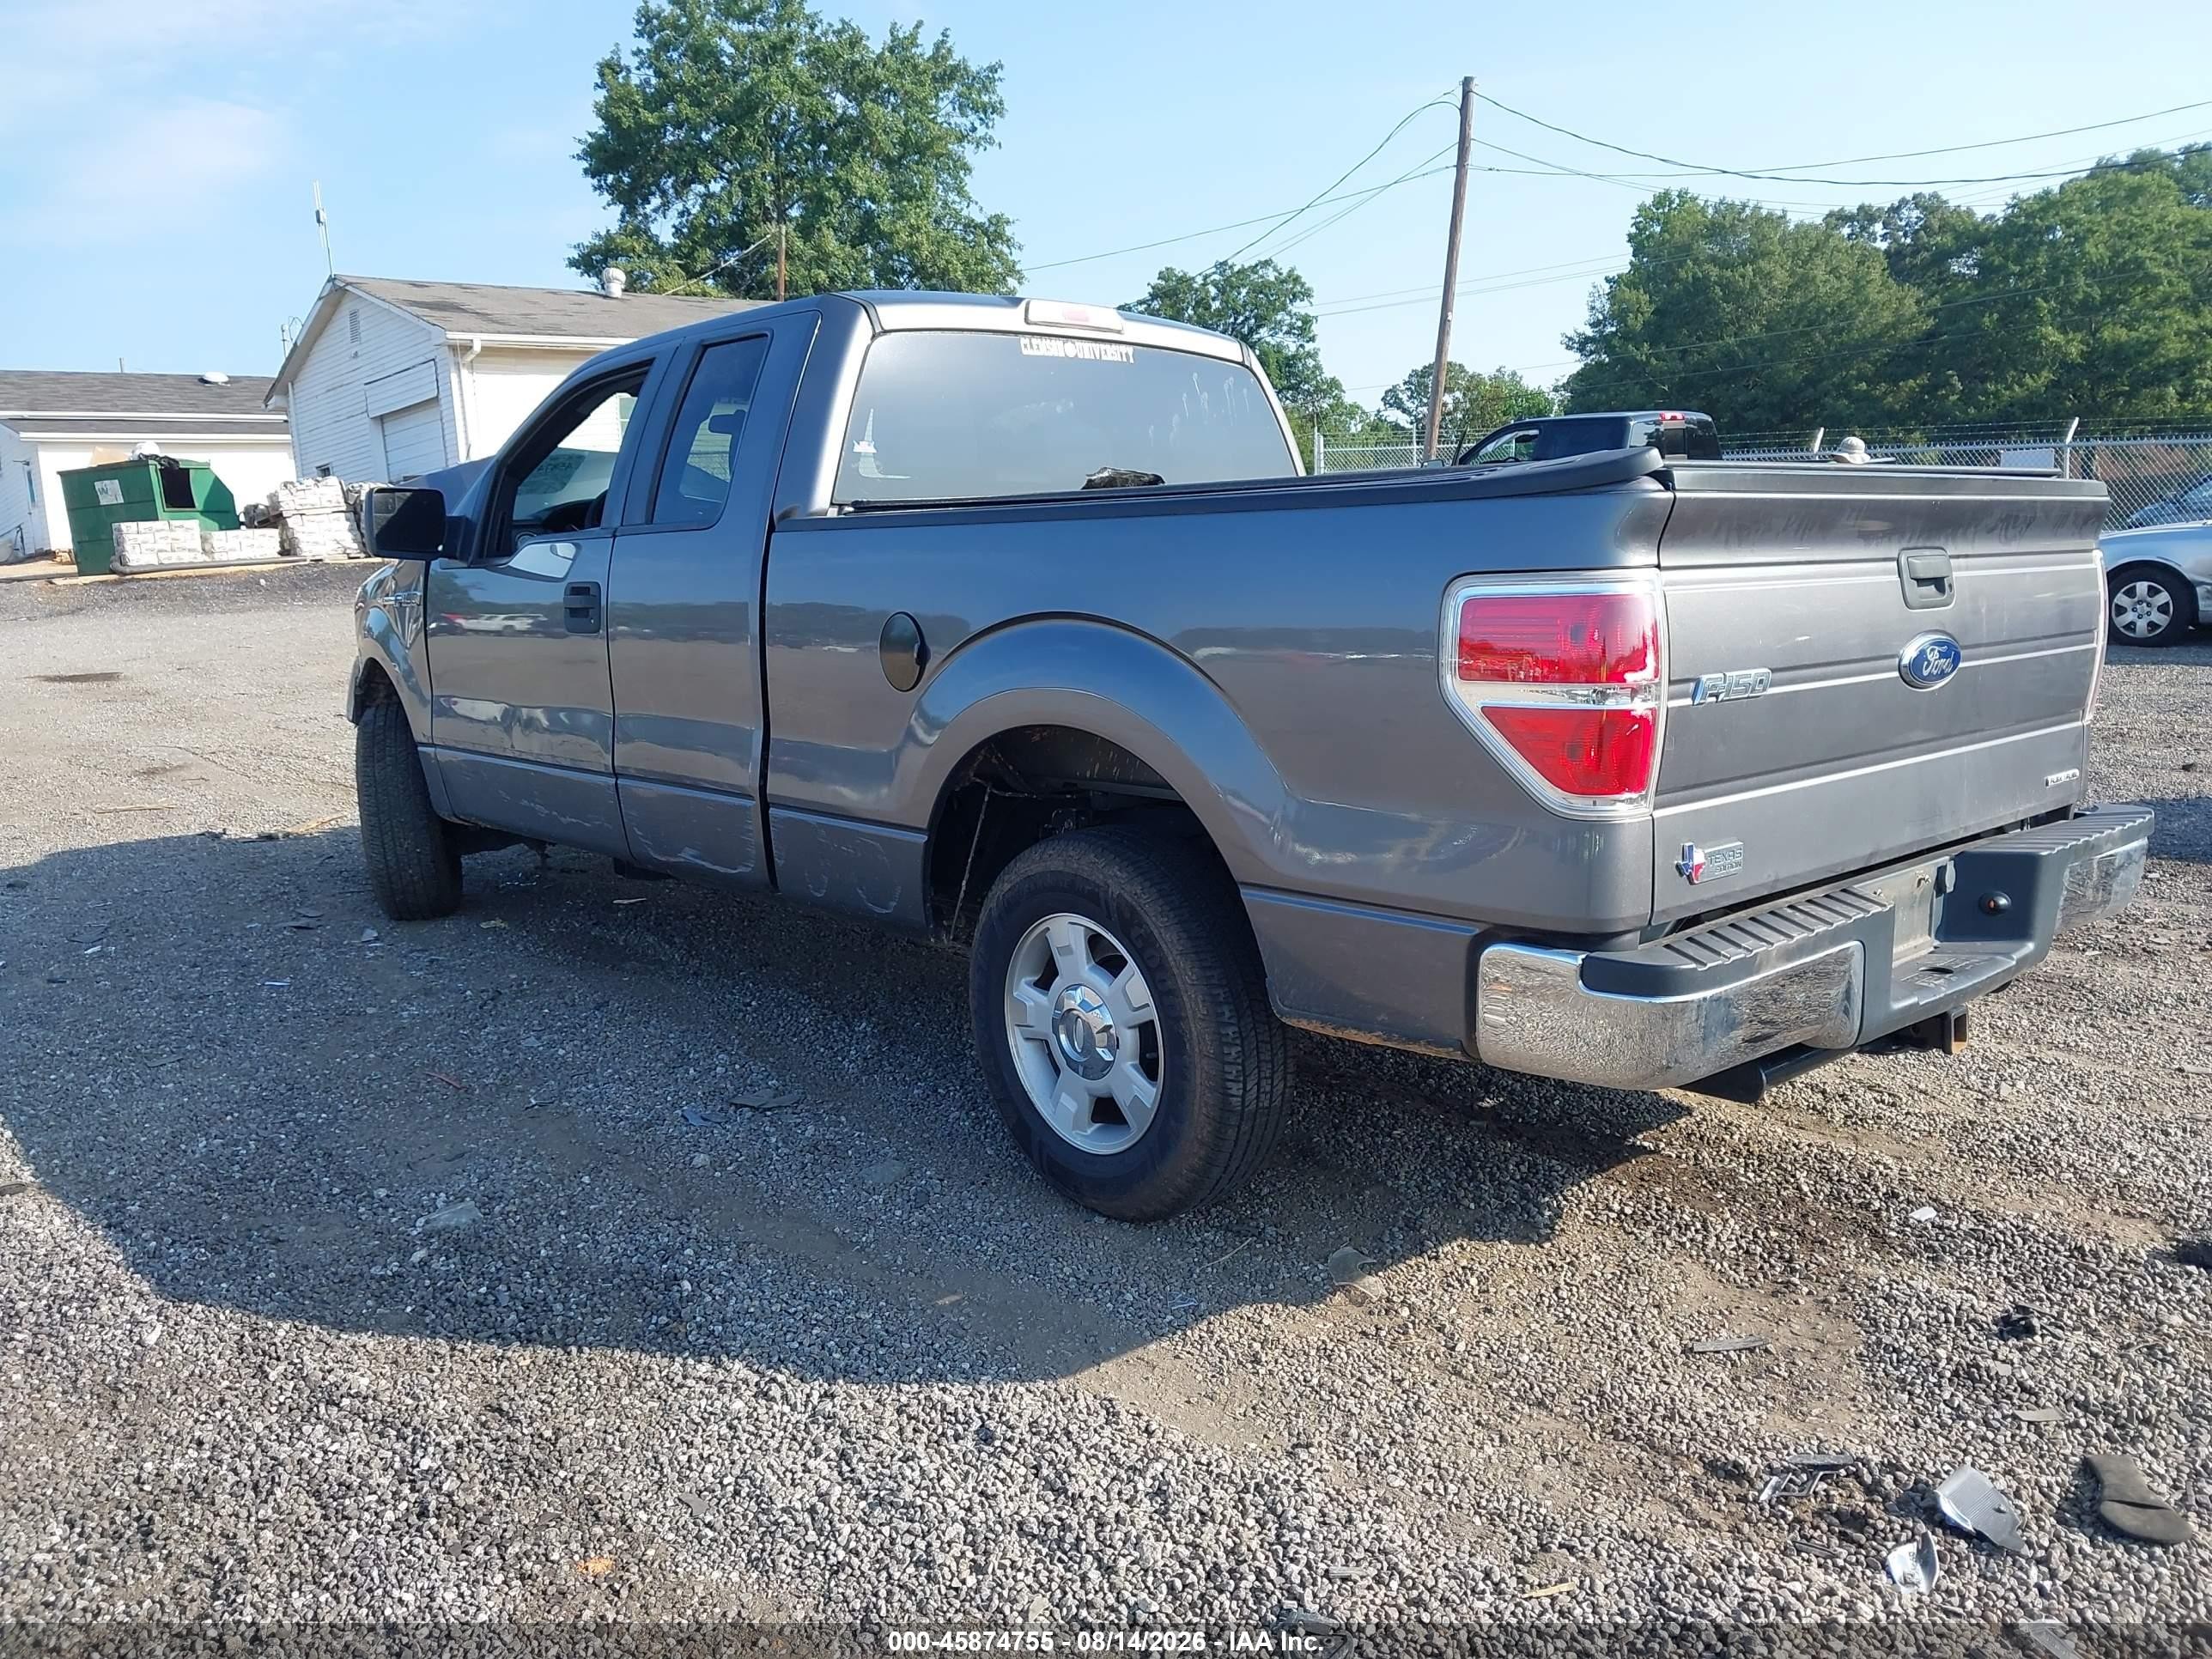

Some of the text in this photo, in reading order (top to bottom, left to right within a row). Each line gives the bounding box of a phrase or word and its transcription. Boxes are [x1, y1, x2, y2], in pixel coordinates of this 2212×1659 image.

[1923, 645, 1955, 677] Ford
[1691, 668, 1772, 706] F-150
[1708, 847, 1743, 866] TEXAS
